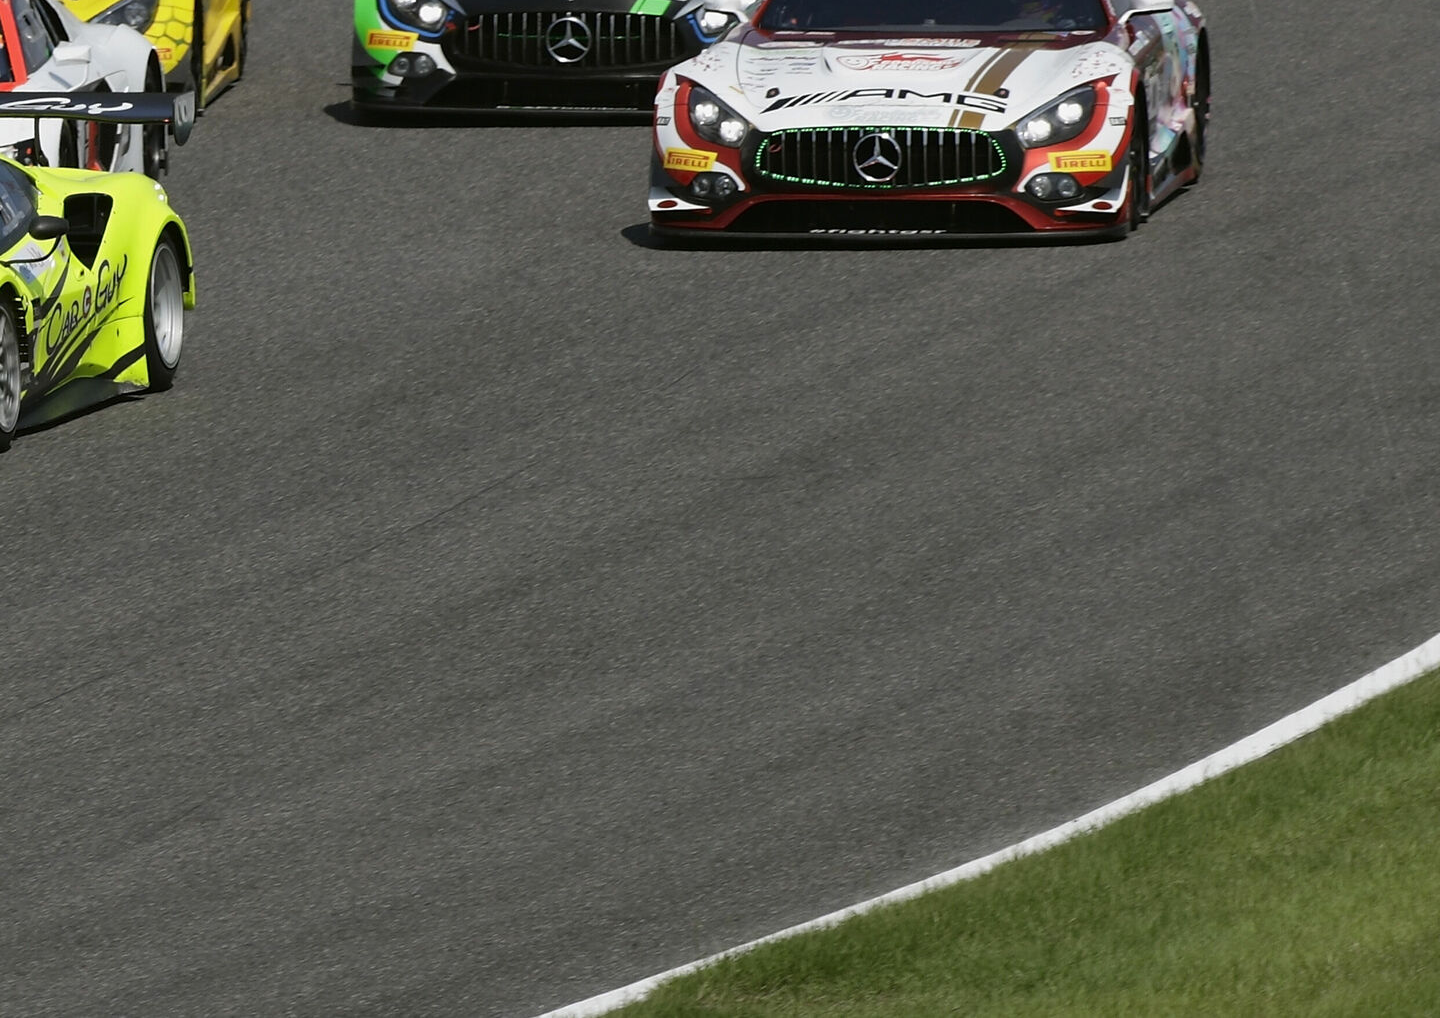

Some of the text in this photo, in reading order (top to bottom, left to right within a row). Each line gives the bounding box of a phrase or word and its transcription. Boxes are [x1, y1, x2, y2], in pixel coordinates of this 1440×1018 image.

[369, 33, 414, 48] PIRELLI
[840, 88, 1007, 113] AMG
[666, 151, 709, 169] PIRELLI
[1055, 153, 1107, 169] PIRELLI
